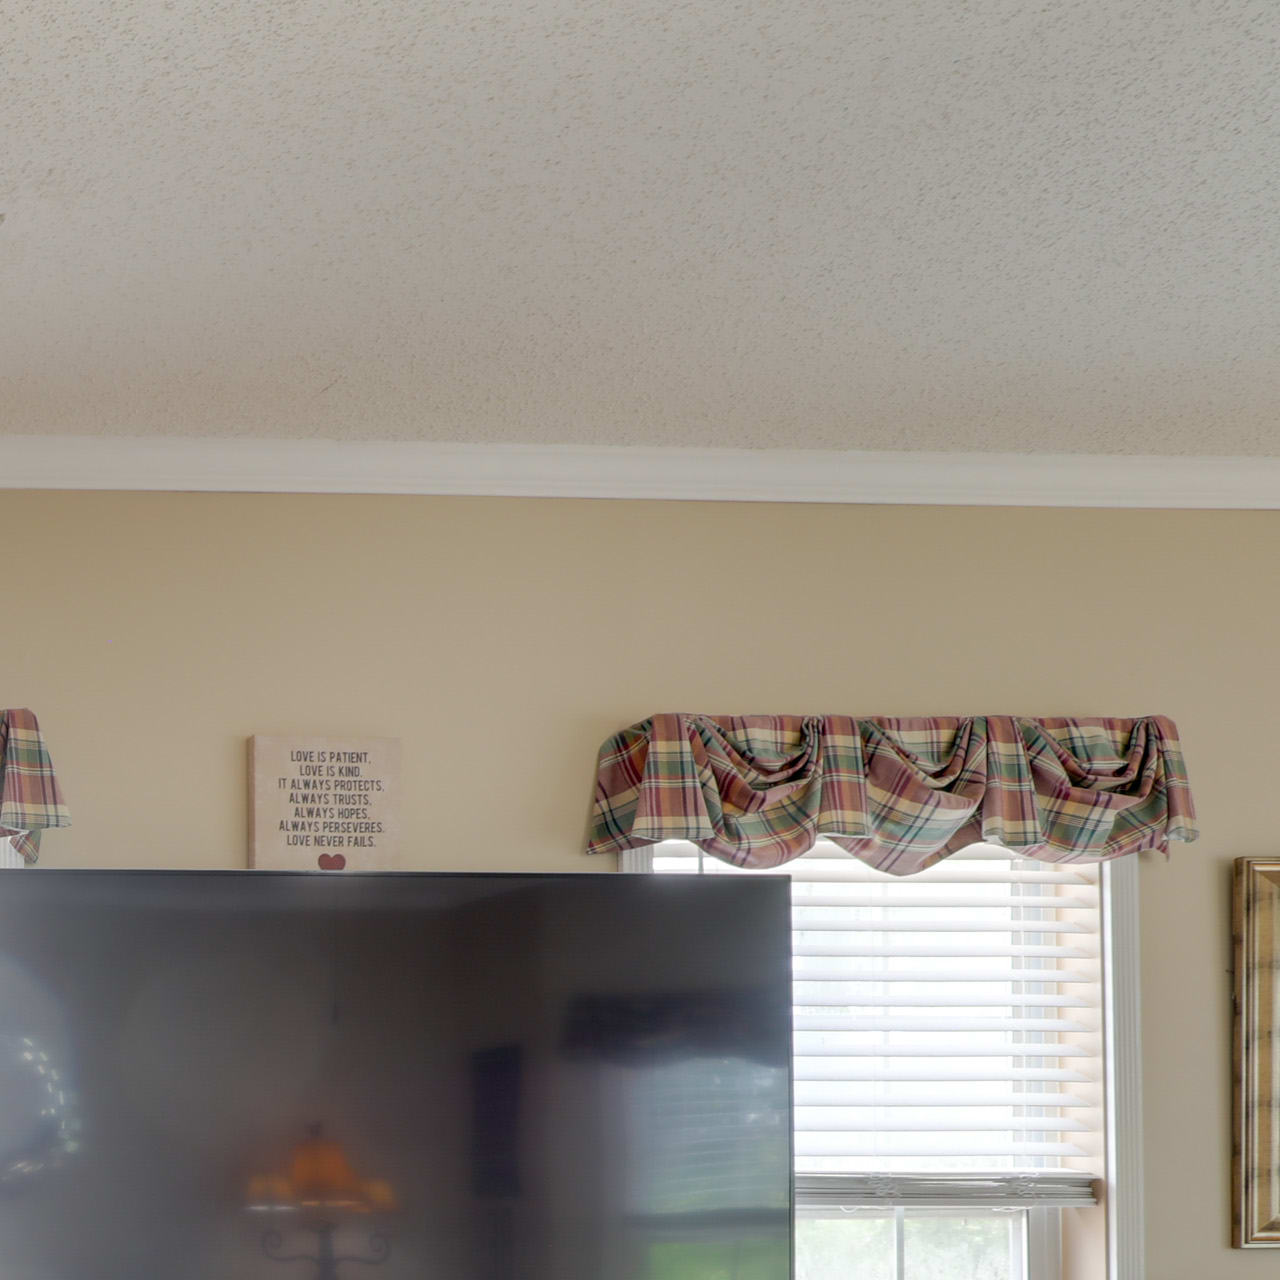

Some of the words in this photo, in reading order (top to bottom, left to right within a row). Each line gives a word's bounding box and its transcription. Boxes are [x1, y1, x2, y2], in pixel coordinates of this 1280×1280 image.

[290, 751, 314, 762] LOVE
[317, 751, 327, 763] IS
[329, 752, 371, 764] PATIENT,
[299, 765, 324, 776] LOVE
[327, 765, 336, 777] IS
[338, 766, 363, 778] KIND.
[278, 778, 287, 789] IT
[290, 778, 331, 790] ALWAYS
[334, 779, 385, 792] PROTECTS,
[289, 793, 330, 805] ALWAYS
[332, 794, 373, 806] TRUSTS,
[294, 807, 335, 819] ALWAYS
[279, 820, 320, 832] ALWAYS
[322, 821, 385, 833] PERSEVERES.
[287, 835, 311, 846] LOVE
[313, 835, 344, 847] NEVER
[346, 836, 377, 848] FAILS.
